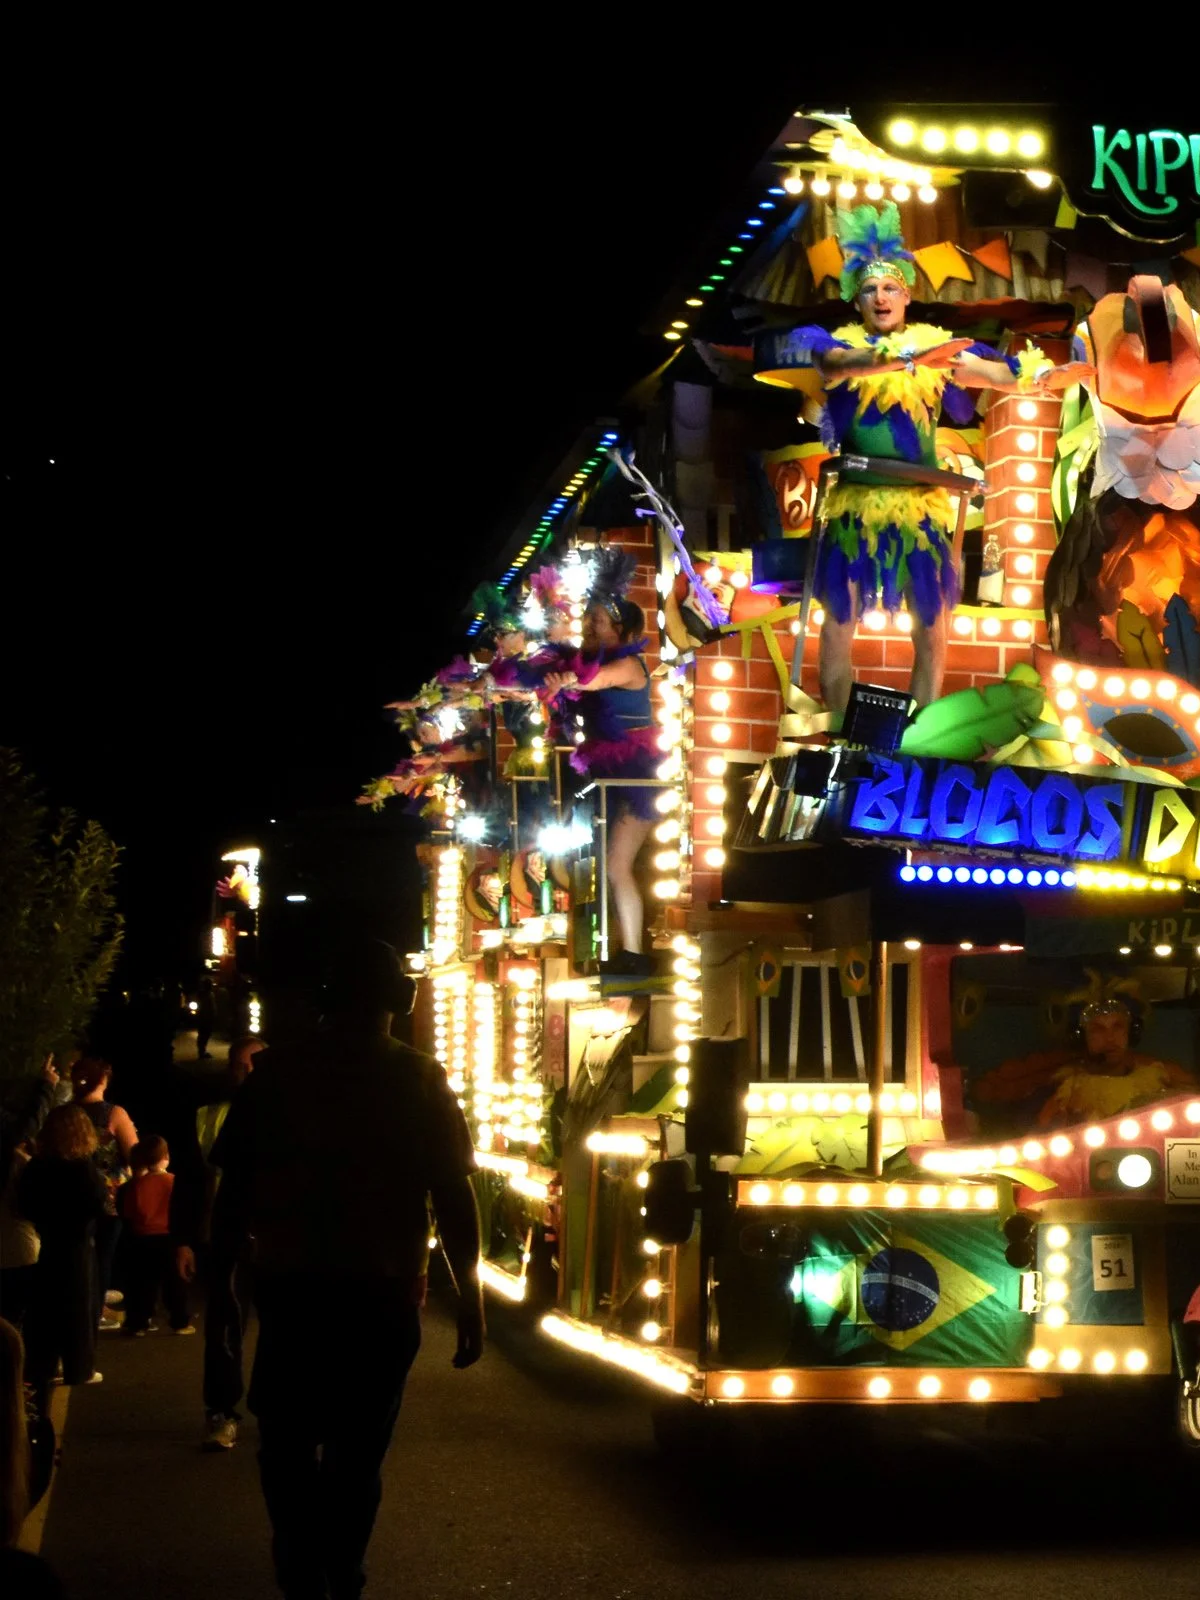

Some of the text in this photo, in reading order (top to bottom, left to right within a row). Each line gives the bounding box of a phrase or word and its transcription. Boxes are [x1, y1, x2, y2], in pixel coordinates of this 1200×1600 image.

[851, 752, 1123, 857] BLOCOS
[1188, 1149, 1197, 1159] In
[1174, 1174, 1199, 1186] Alan
[1100, 1258, 1128, 1279] 51
